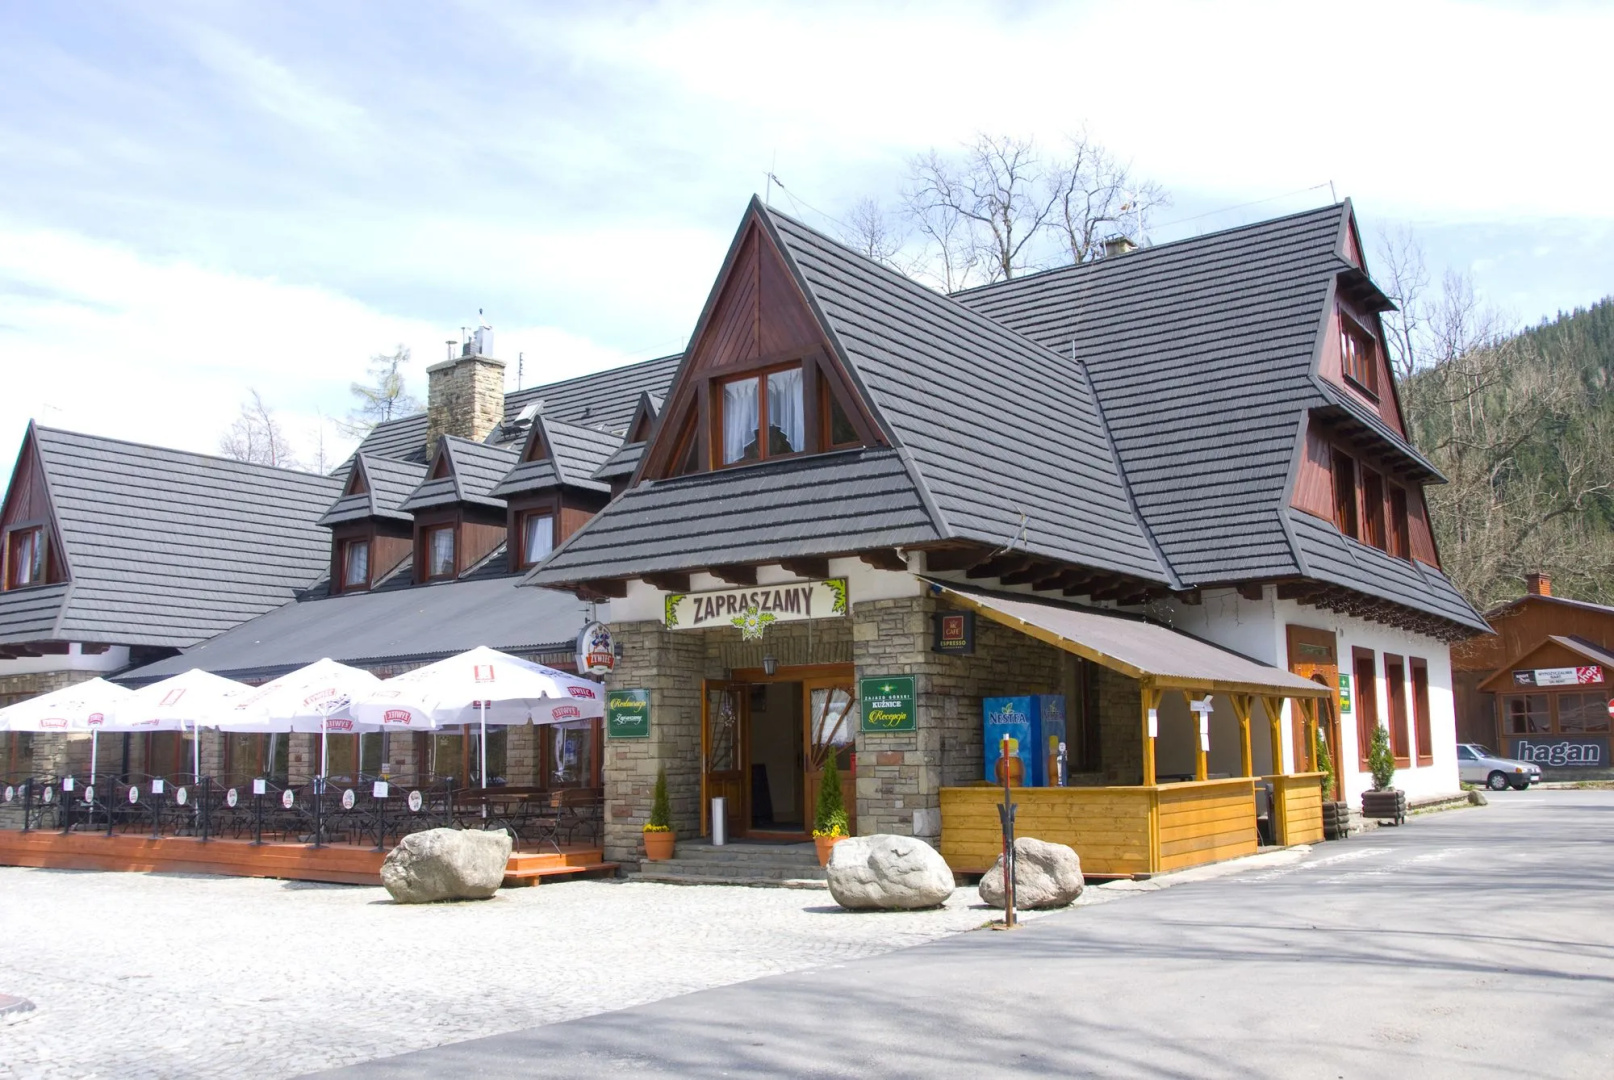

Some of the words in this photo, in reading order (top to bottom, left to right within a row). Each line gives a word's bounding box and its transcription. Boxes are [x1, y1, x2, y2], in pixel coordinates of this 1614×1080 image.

[693, 587, 813, 624] ZAPRASZAMY
[872, 699, 902, 708] KUŹNICE
[868, 709, 907, 727] Recepcja
[989, 711, 1029, 724] NESTEA
[1518, 741, 1600, 766] hagan
